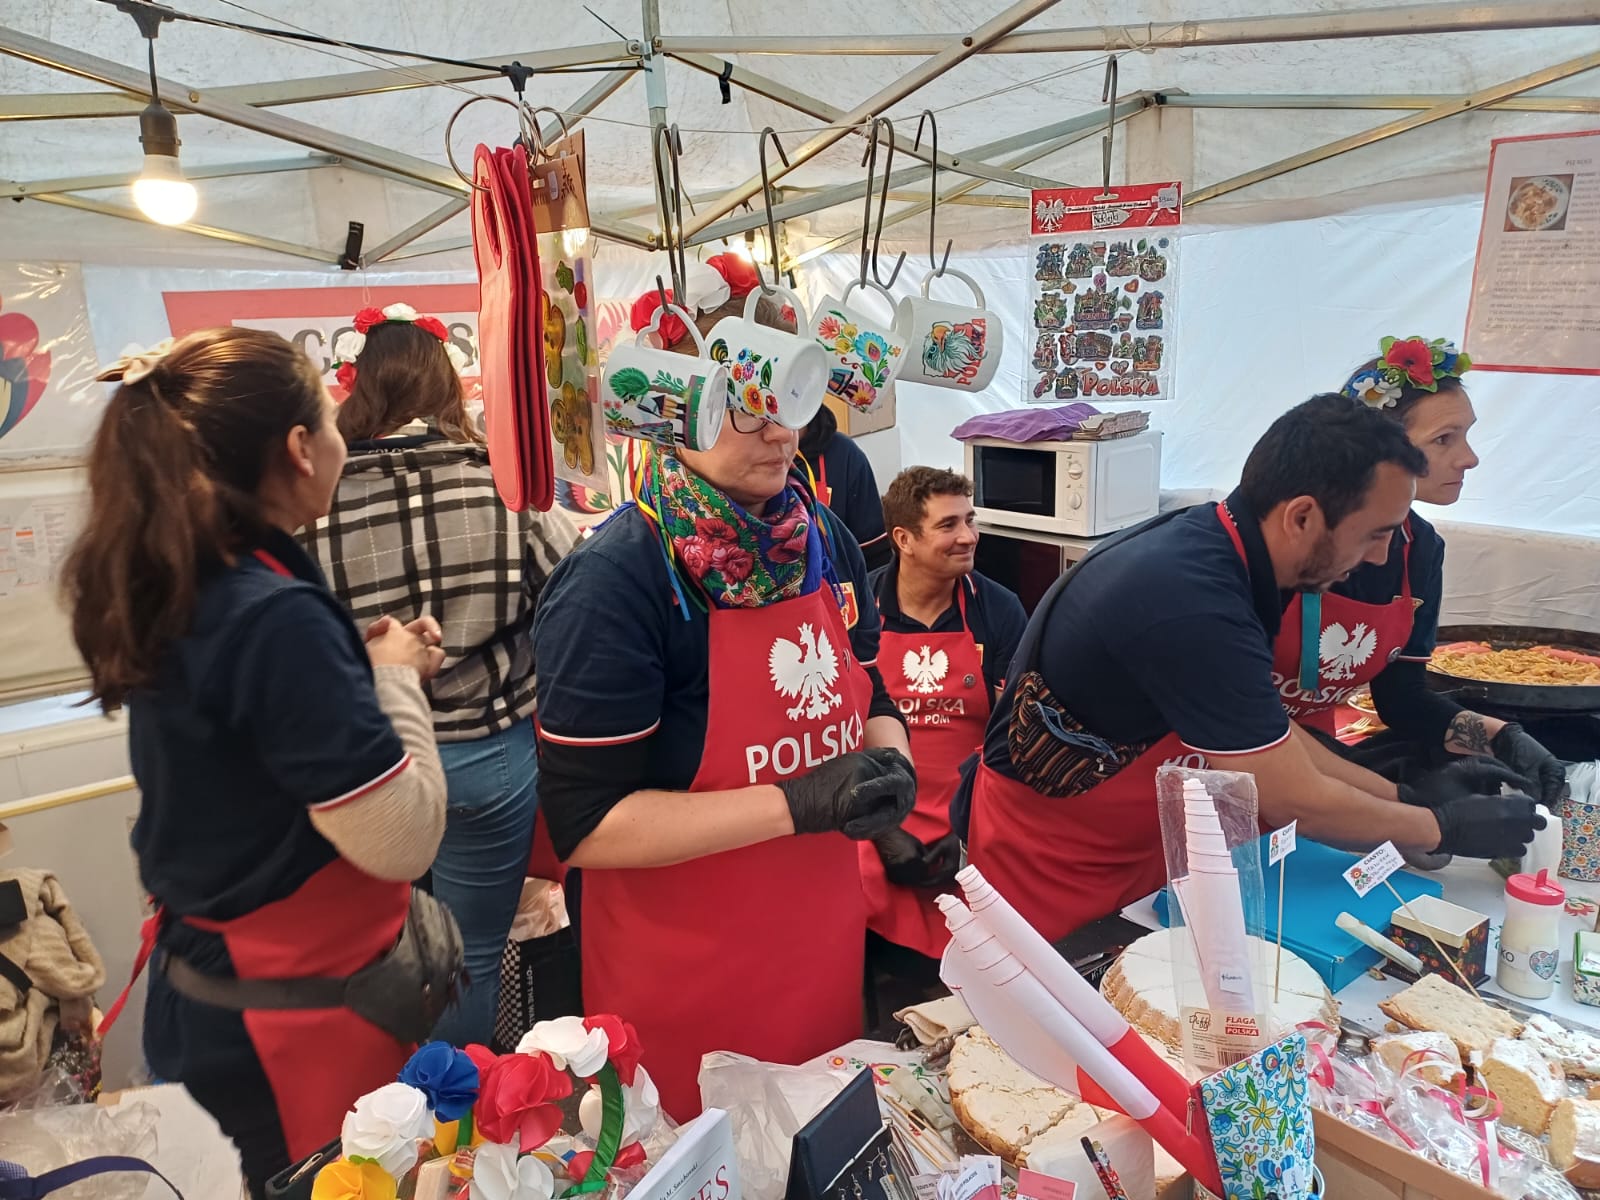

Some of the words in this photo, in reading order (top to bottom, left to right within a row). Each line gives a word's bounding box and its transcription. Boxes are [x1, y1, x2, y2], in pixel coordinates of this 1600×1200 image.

[1082, 371, 1160, 397] POLSKA
[890, 698, 965, 715] OLSKA
[745, 709, 864, 784] POLSKA
[1225, 1016, 1256, 1025] FLAGA
[1226, 1027, 1257, 1036] POLSKA
